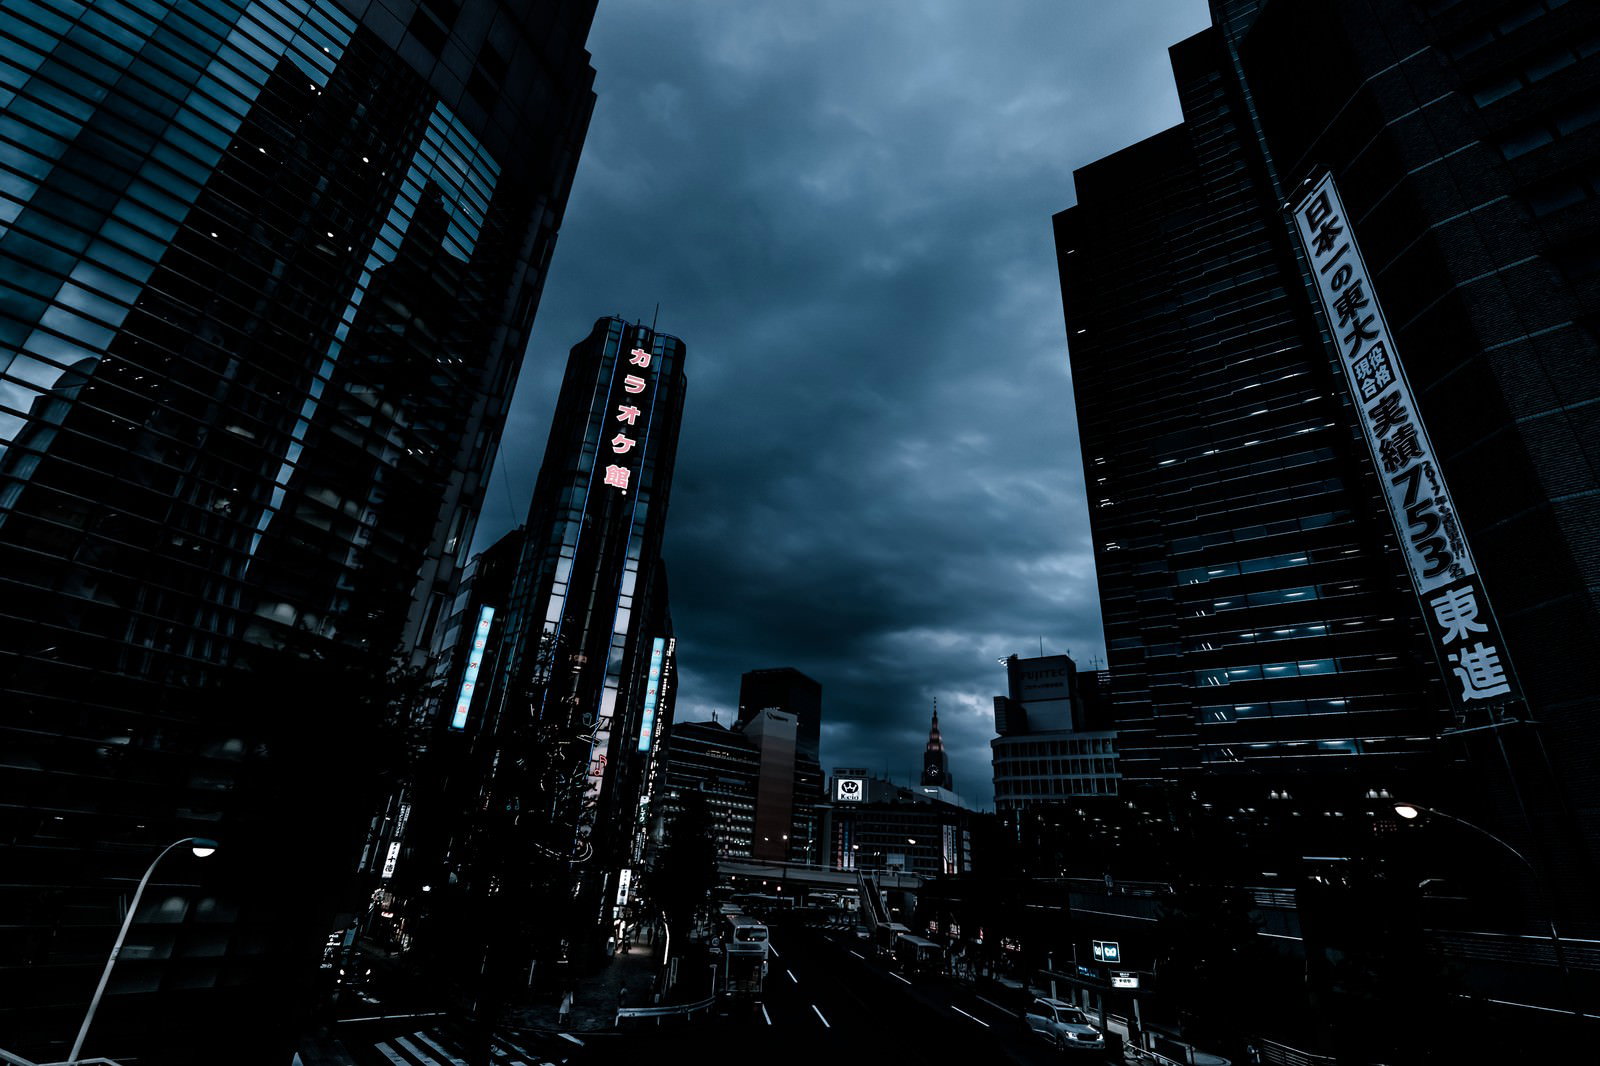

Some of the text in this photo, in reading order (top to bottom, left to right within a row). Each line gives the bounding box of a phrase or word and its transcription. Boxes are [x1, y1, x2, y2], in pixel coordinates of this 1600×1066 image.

[1305, 189, 1380, 358] 日本一の東大
[604, 349, 651, 489] カラオケ館
[1430, 585, 1511, 702] 東進
